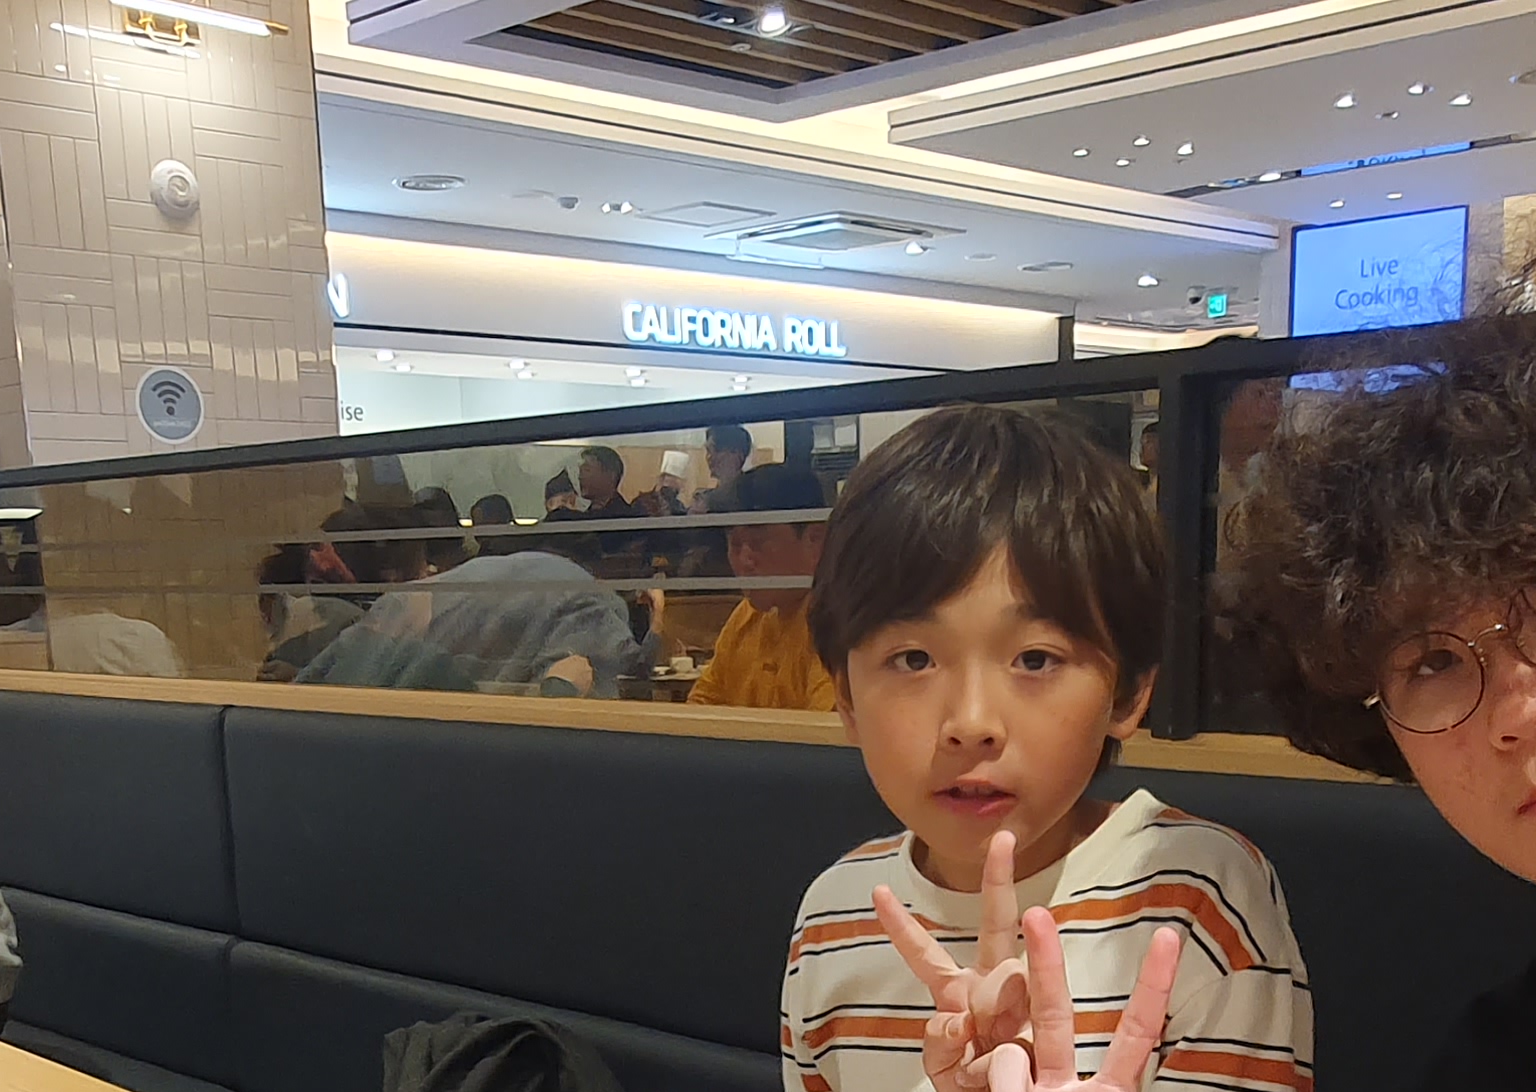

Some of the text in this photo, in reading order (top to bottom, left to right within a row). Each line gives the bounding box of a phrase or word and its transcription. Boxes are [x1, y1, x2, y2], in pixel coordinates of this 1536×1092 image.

[1360, 258, 1399, 278] Live
[1335, 283, 1419, 310] Cooking
[623, 302, 847, 357] CALIFORNIA ROLL
